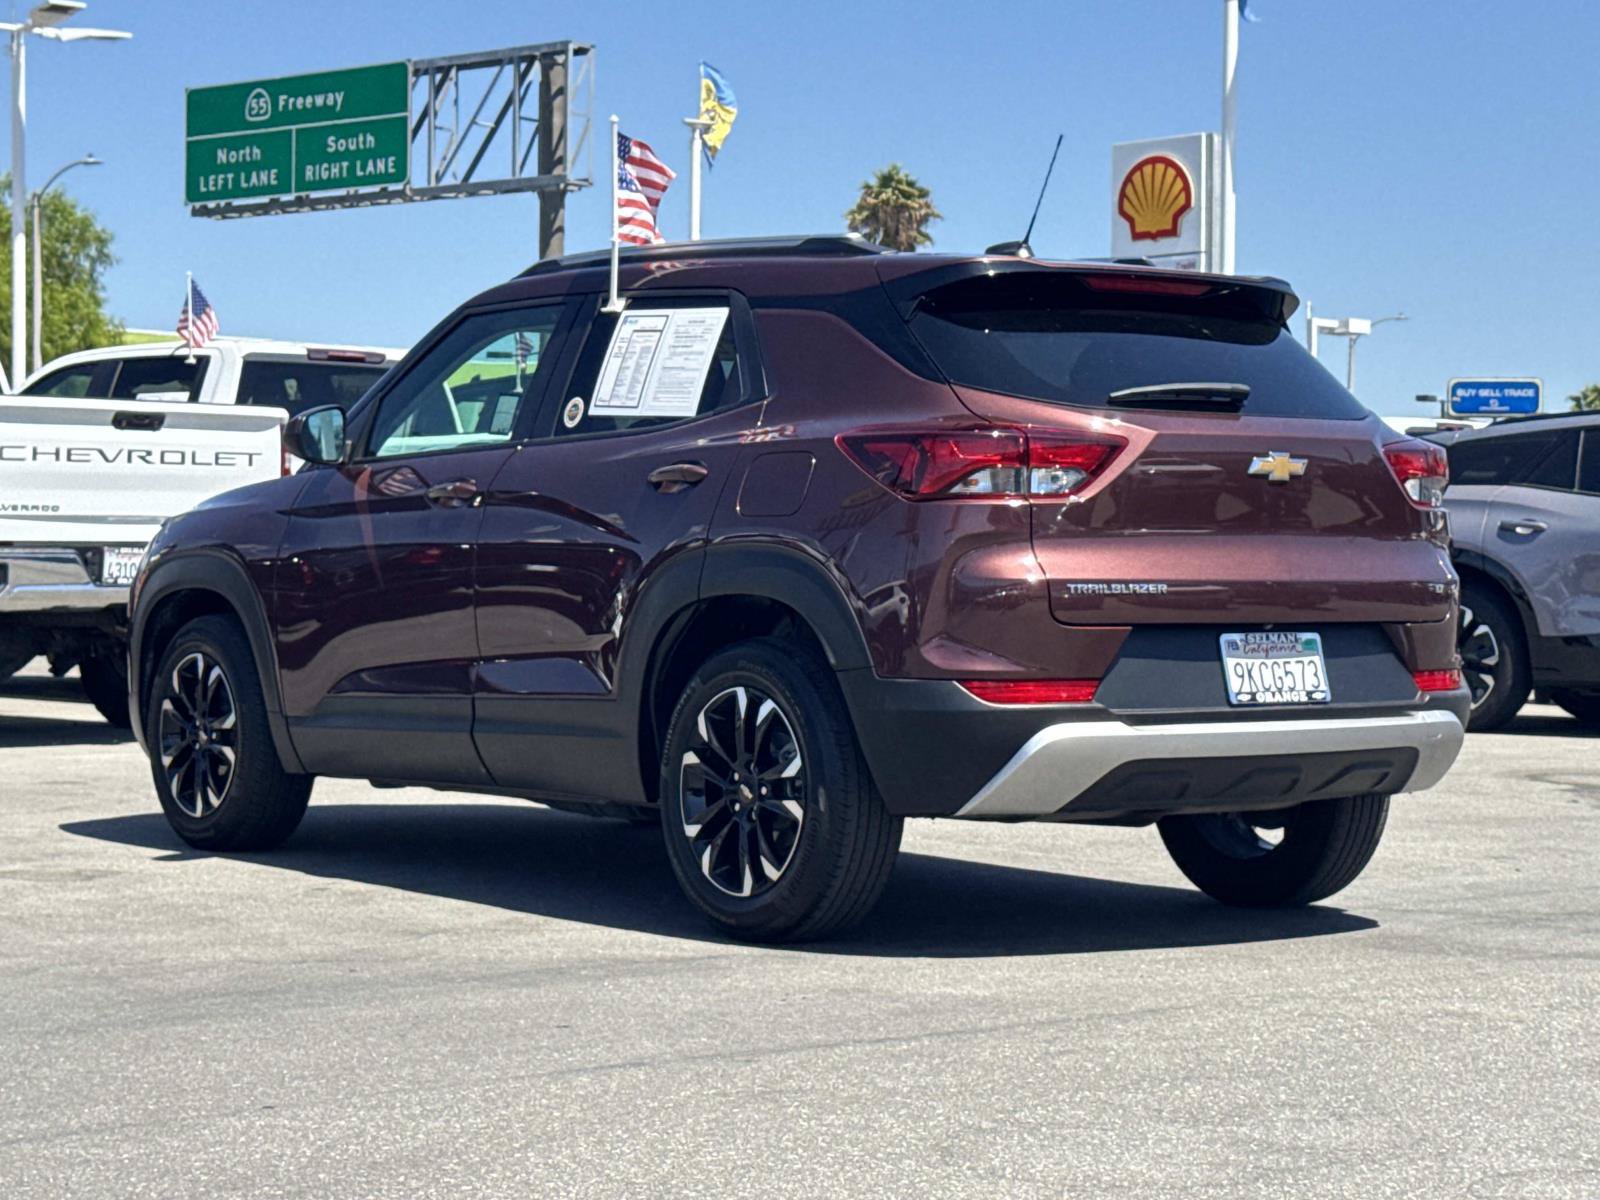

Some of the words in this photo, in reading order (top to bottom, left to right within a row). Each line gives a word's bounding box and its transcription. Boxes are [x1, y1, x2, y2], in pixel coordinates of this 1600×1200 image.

[250, 99, 267, 115] 55
[278, 91, 345, 112] Freeway
[326, 133, 375, 153] South
[216, 146, 261, 164] North
[304, 161, 349, 182] RIGHT
[356, 156, 397, 177] LANE
[199, 173, 234, 192] LEFT
[240, 169, 279, 188] LANE
[1456, 388, 1477, 397] BUY
[1478, 388, 1501, 397] SELL
[0, 445, 263, 467] CHEVROLET
[0, 503, 60, 512] VERADO
[1066, 583, 1168, 594] TRAILBLAZER
[1247, 633, 1296, 644] SELMAN
[1243, 643, 1303, 658] California
[1233, 660, 1321, 692] 9KCG573
[1255, 690, 1309, 702] ORANGE
